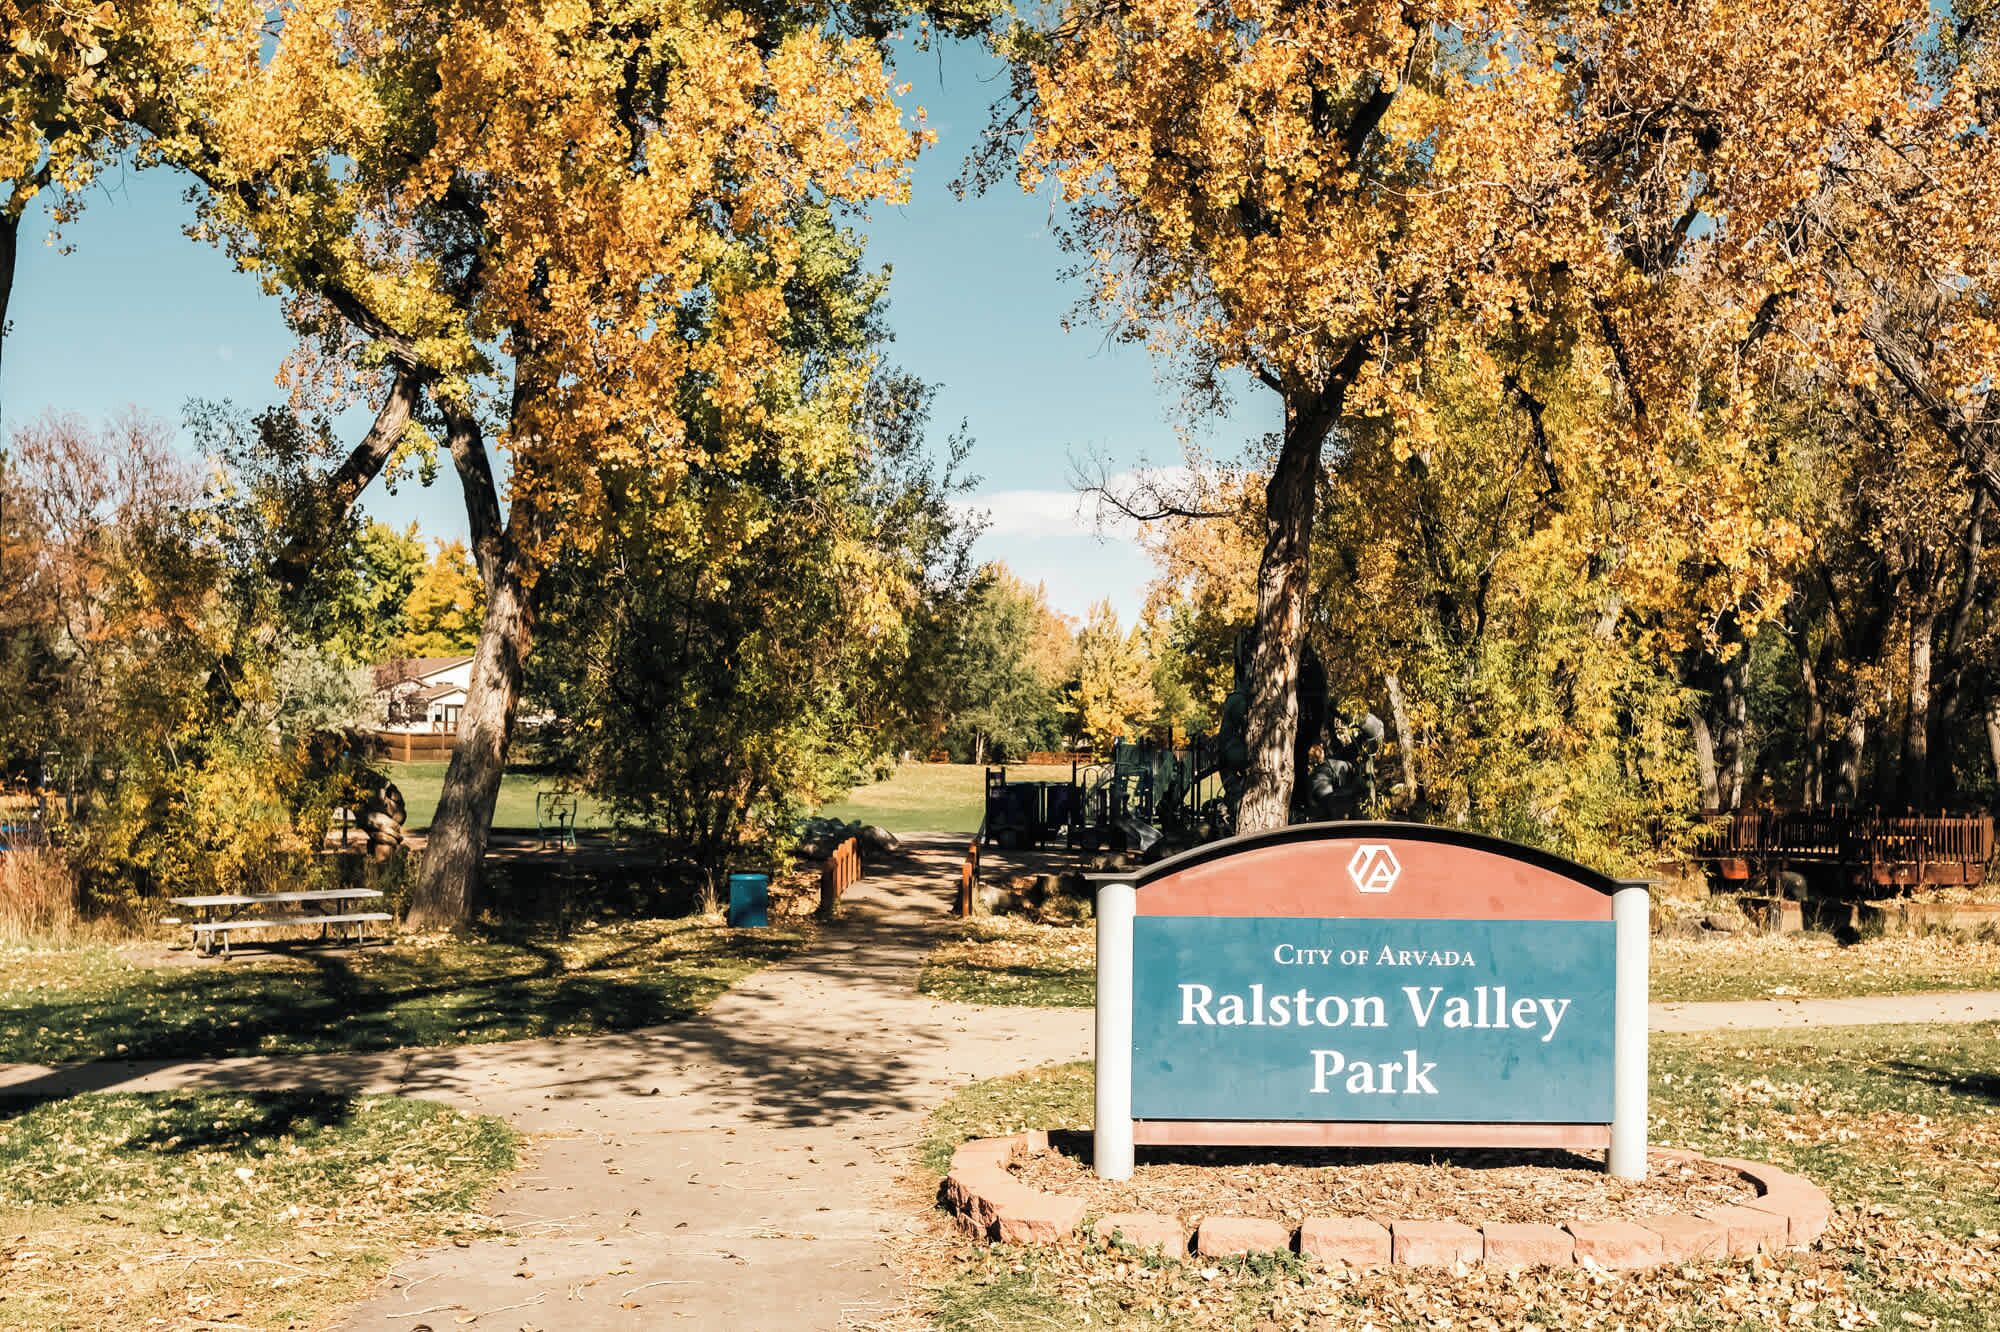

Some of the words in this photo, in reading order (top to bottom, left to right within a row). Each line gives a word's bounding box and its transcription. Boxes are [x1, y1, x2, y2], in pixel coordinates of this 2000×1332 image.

[1177, 983, 1389, 1028] Ralston
[1401, 985, 1572, 1043] Valley
[1309, 1049, 1440, 1095] Park
